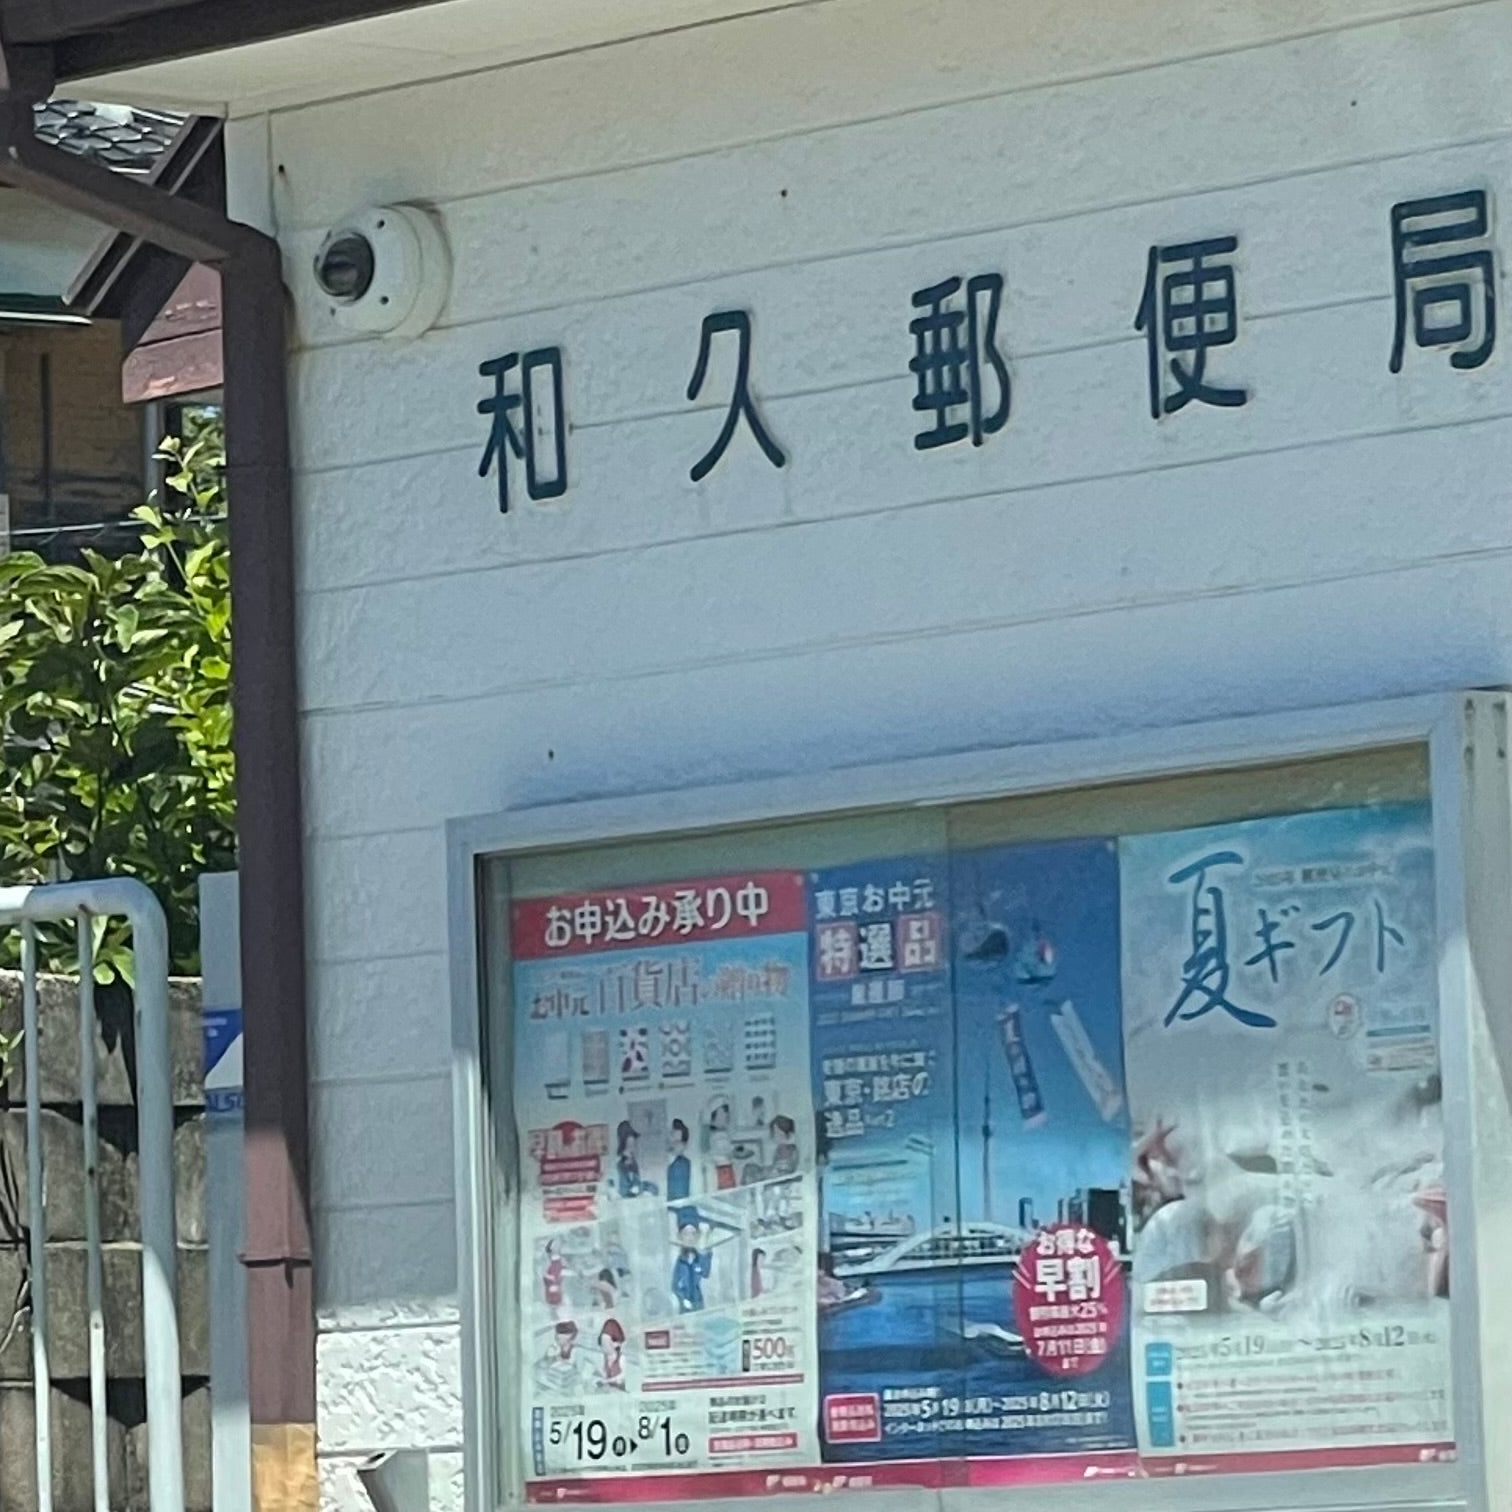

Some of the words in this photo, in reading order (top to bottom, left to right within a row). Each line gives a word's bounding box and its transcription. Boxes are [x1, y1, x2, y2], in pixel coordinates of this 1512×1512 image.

[477, 188, 1496, 514] 和久郵便局
[544, 881, 769, 947] お申込み承り中
[815, 878, 935, 920] 東京お中元
[819, 919, 936, 975] 特選品
[1164, 850, 1405, 1028] 夏ギフト
[1037, 1228, 1096, 1255] お得な
[1034, 1255, 1101, 1302] 早割
